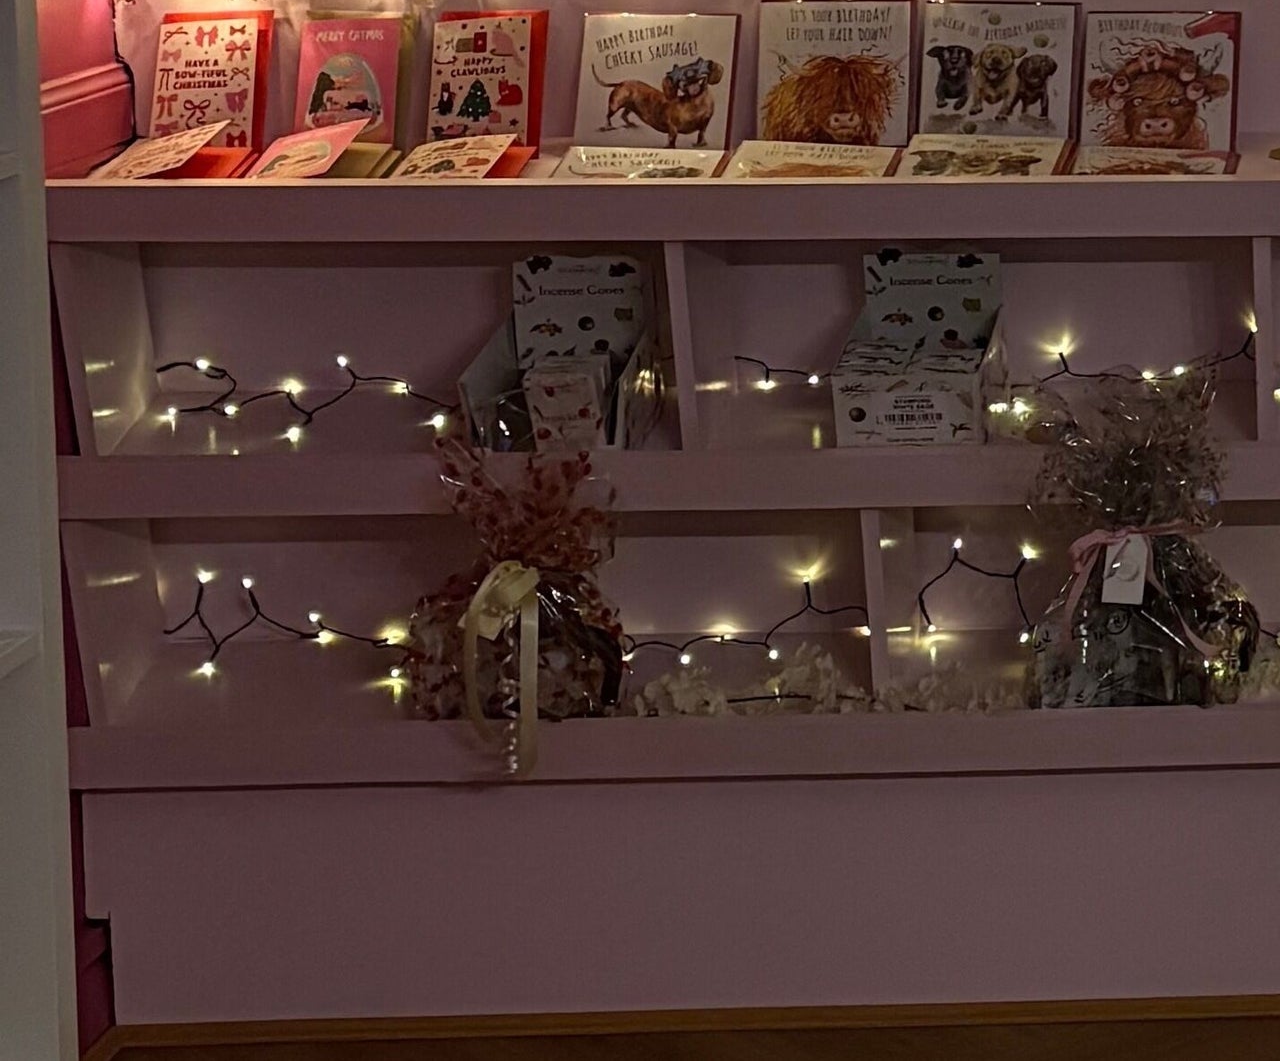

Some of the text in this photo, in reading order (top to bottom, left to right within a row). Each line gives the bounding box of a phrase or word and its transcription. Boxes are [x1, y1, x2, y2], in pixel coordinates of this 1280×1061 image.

[595, 24, 674, 53] HAPPY BIRTHDAY
[604, 40, 699, 70] CHEEKY SAUSAGE!
[185, 58, 219, 69] HAVE A
[463, 56, 493, 67] HAPPY
[174, 69, 229, 81] BOW-TIFUL
[450, 64, 506, 78] CLAWLIDAYS
[173, 79, 229, 91] CHRISTMAS
[890, 275, 973, 287] Incense Cones
[538, 284, 625, 297] Incense Cones
